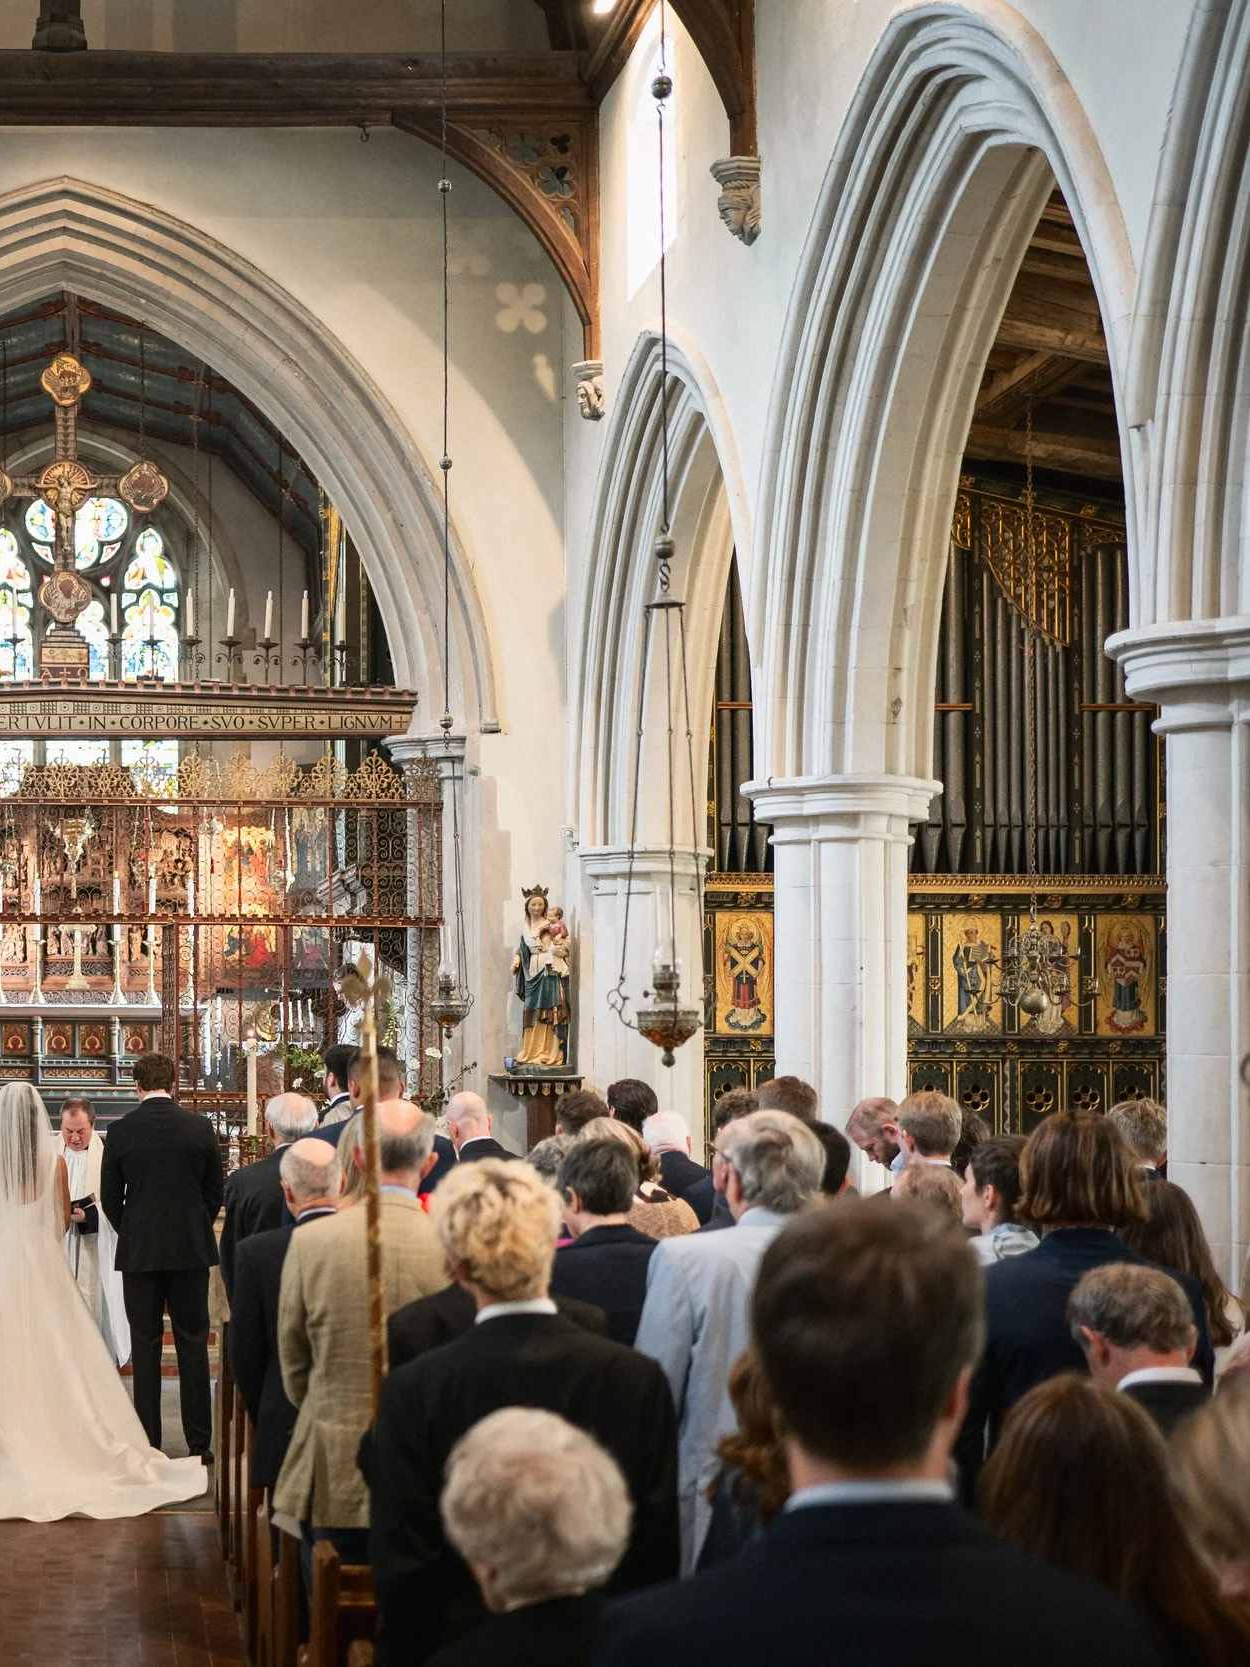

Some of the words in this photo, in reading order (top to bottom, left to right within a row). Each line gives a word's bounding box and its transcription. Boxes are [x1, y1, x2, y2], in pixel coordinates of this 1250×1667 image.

[88, 716, 107, 730] IN
[119, 716, 203, 730] CORPORE
[210, 716, 245, 730] SVO
[257, 716, 318, 730] SVPER
[327, 716, 393, 730] LIGNVM
